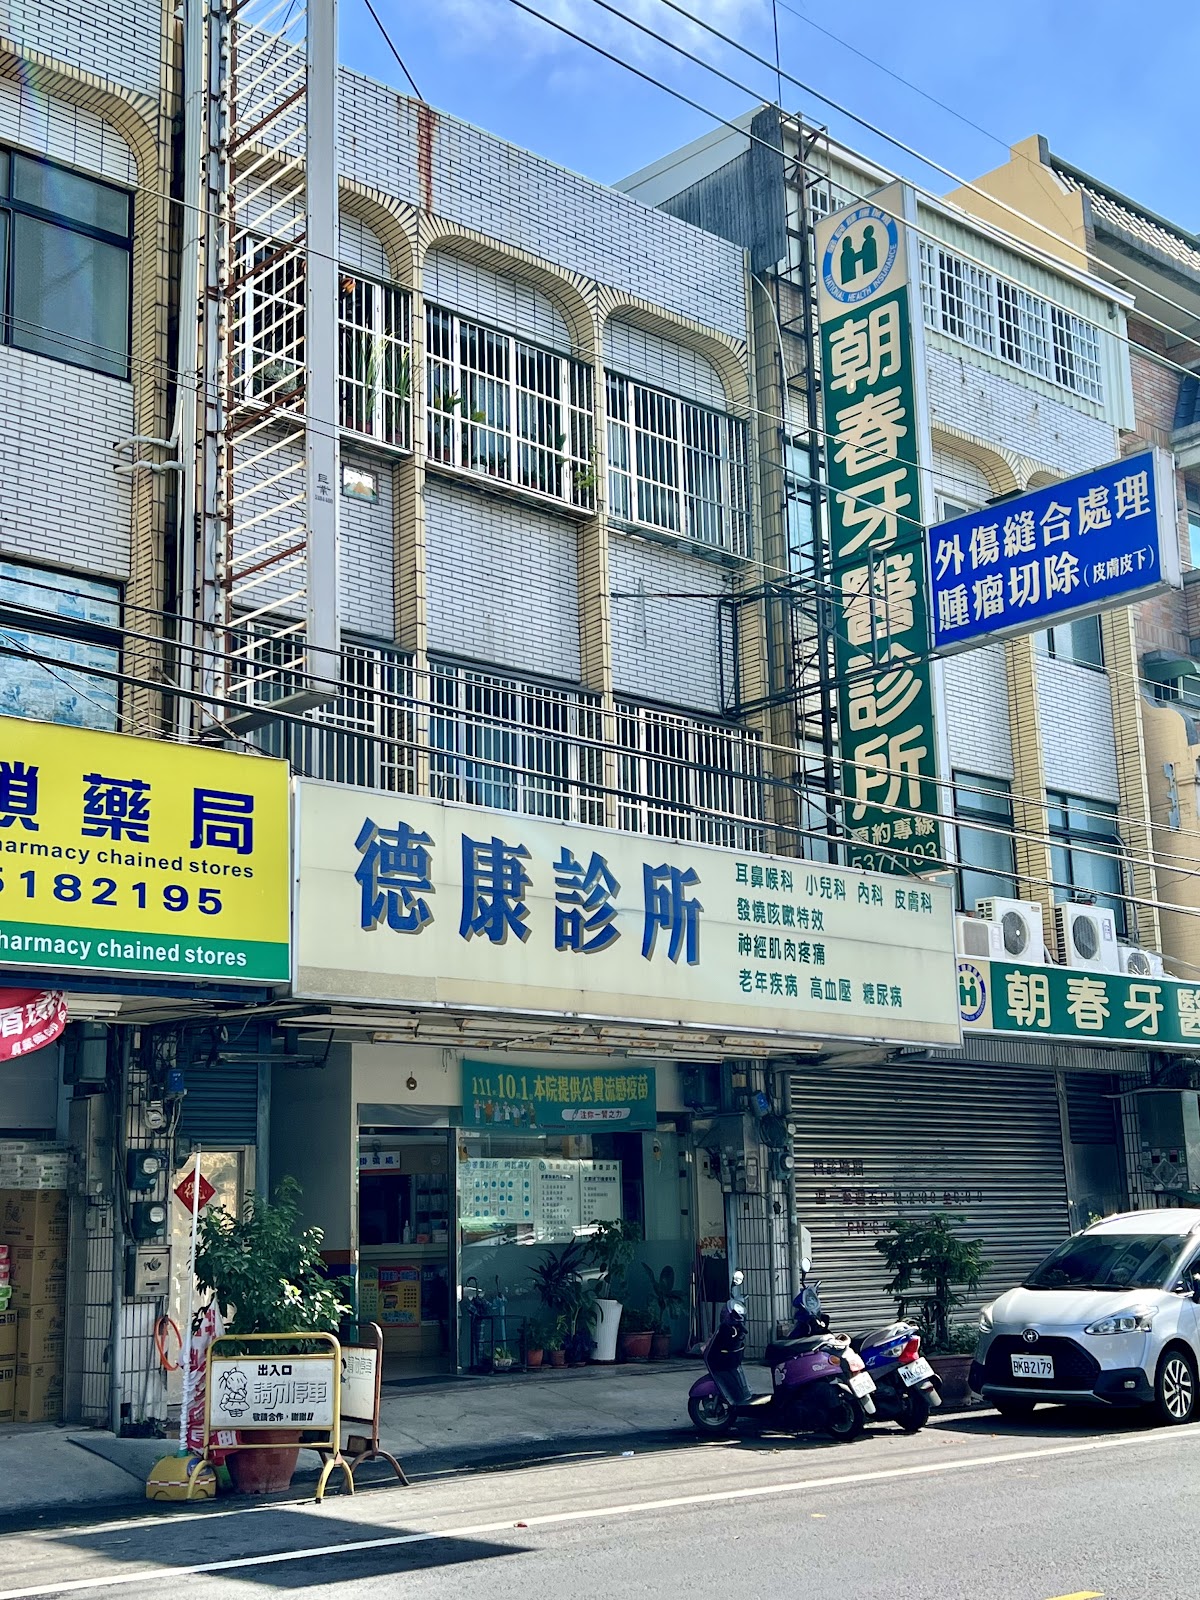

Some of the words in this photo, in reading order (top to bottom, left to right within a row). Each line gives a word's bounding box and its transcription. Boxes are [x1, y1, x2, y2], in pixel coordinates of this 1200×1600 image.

[824, 274, 845, 302] NATIONAL
[847, 287, 872, 302] HEALTH
[873, 244, 897, 289] INSURANCE
[934, 470, 1151, 581] 外傷縫合處理
[829, 300, 928, 821] 朝春牙醫診所
[97, 848, 183, 872] chained
[189, 860, 254, 878] stores
[0, 866, 223, 916] 182195
[353, 816, 704, 967] 德康診所
[735, 862, 794, 894] 耳鼻喉科
[806, 874, 846, 901] 小兒科
[895, 888, 933, 914] 皮膚科
[736, 897, 825, 931] 發燒咳嗽特效
[97, 939, 180, 962] chained
[185, 946, 248, 967] stores
[738, 932, 826, 966] 神經肌肉疼痛
[739, 968, 798, 998] 老年疾病
[810, 977, 852, 1002] 高血壓
[862, 982, 903, 1008] 糖尿病
[257, 1363, 292, 1377] 出入口
[1013, 1360, 1052, 1375] BKB-2179
[253, 1380, 327, 1410] 請勿停車
